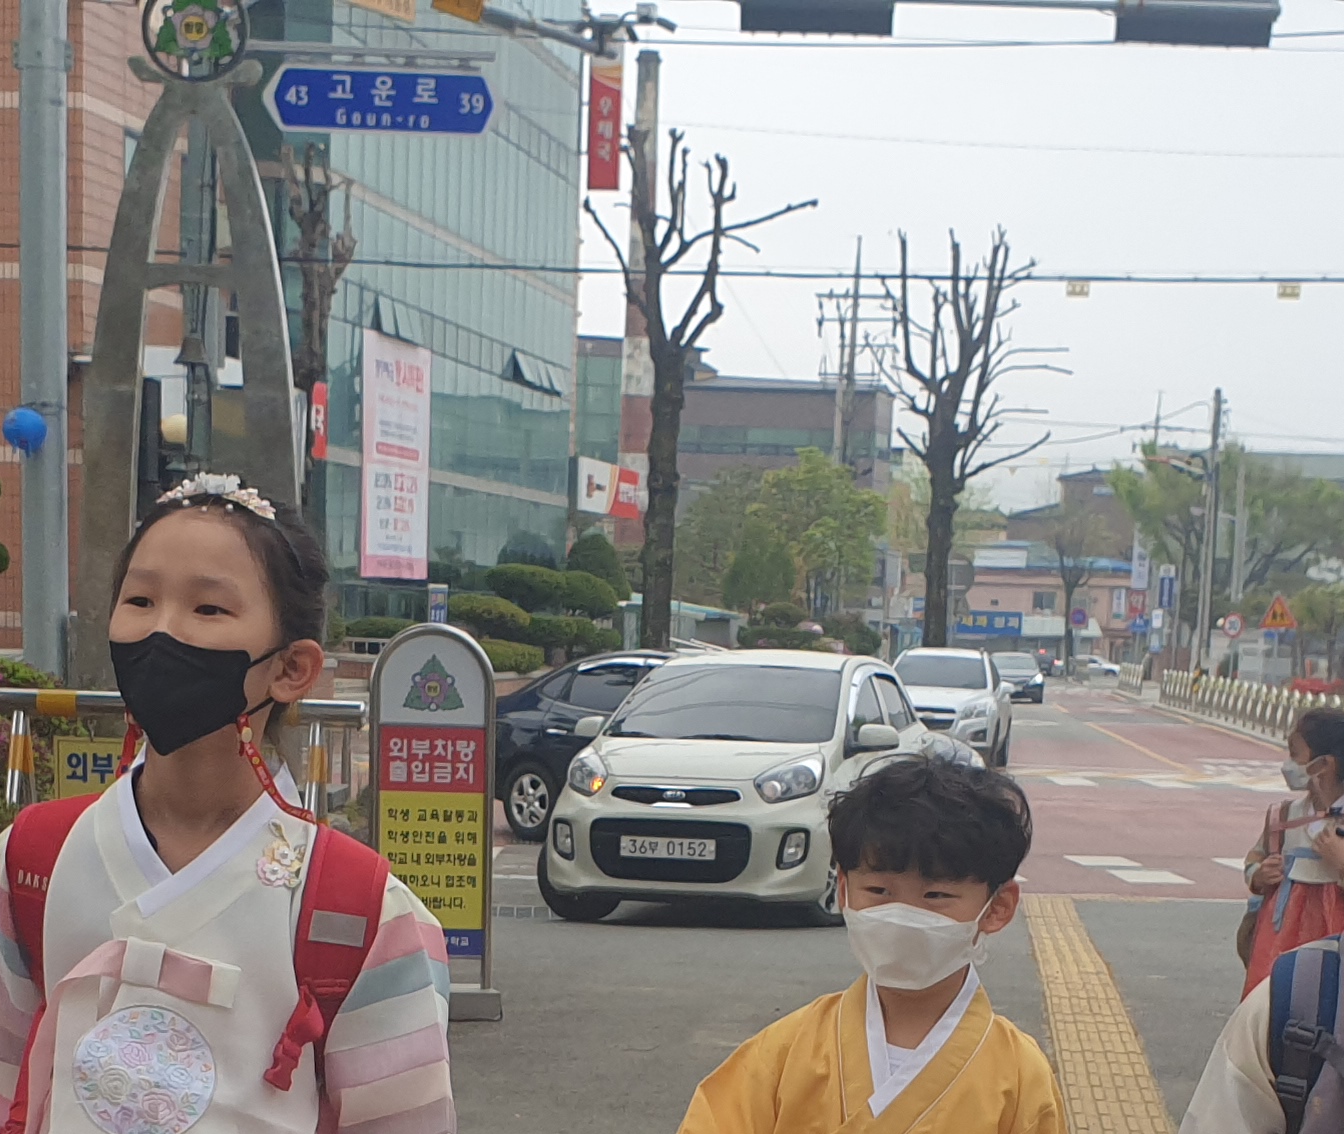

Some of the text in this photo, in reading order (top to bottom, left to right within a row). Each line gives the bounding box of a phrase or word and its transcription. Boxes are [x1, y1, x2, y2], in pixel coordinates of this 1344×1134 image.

[284, 74, 484, 114] 43 고운로 39
[336, 109, 430, 128] Goun-ro
[389, 738, 476, 761] 외부차량
[66, 752, 129, 784] 외부
[389, 760, 473, 784] 출입금지
[388, 808, 478, 823] 학생 교육활동과
[388, 830, 477, 844] 학생안전을 위해
[666, 841, 706, 857] 0152
[388, 852, 476, 866] 학교 내 외부차량을
[18, 869, 48, 891] DAKS
[445, 874, 476, 888] 협조해
